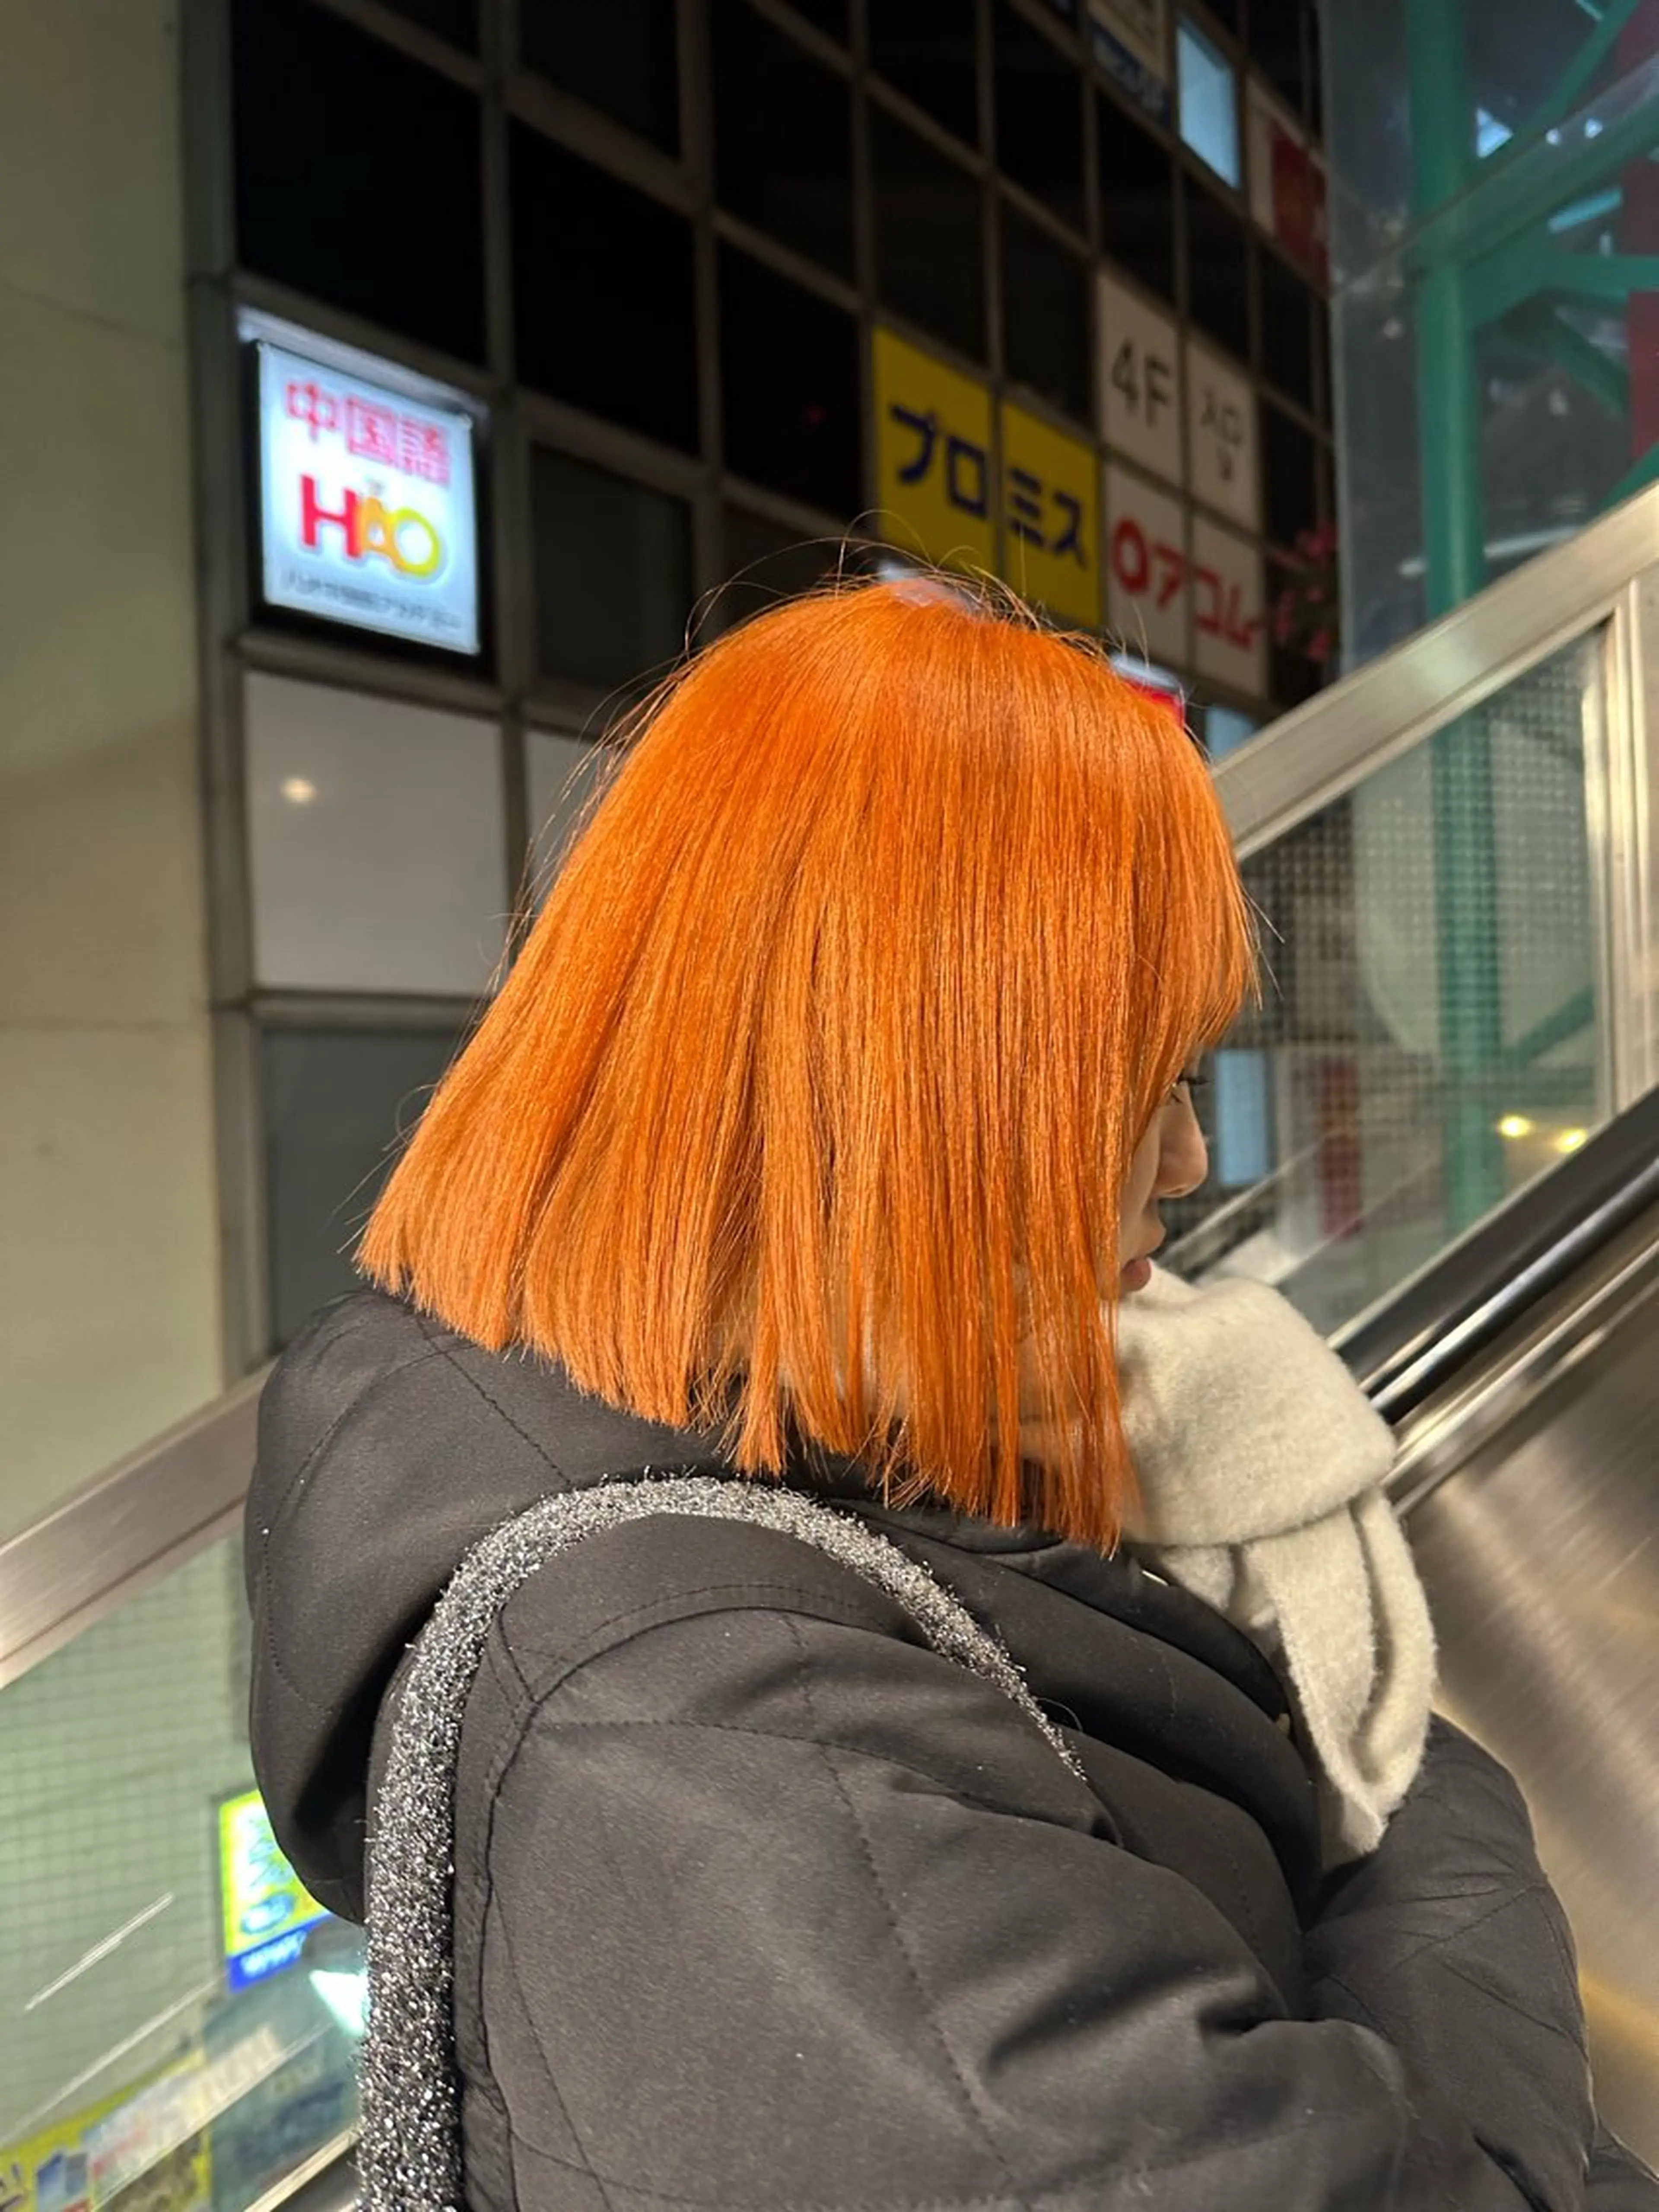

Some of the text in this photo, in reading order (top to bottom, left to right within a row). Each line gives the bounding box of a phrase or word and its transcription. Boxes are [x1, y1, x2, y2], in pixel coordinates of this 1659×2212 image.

[286, 381, 451, 487] 中国語
[1110, 339, 1170, 427] 4F
[300, 473, 442, 578] HAO
[890, 403, 1088, 571] プロミス
